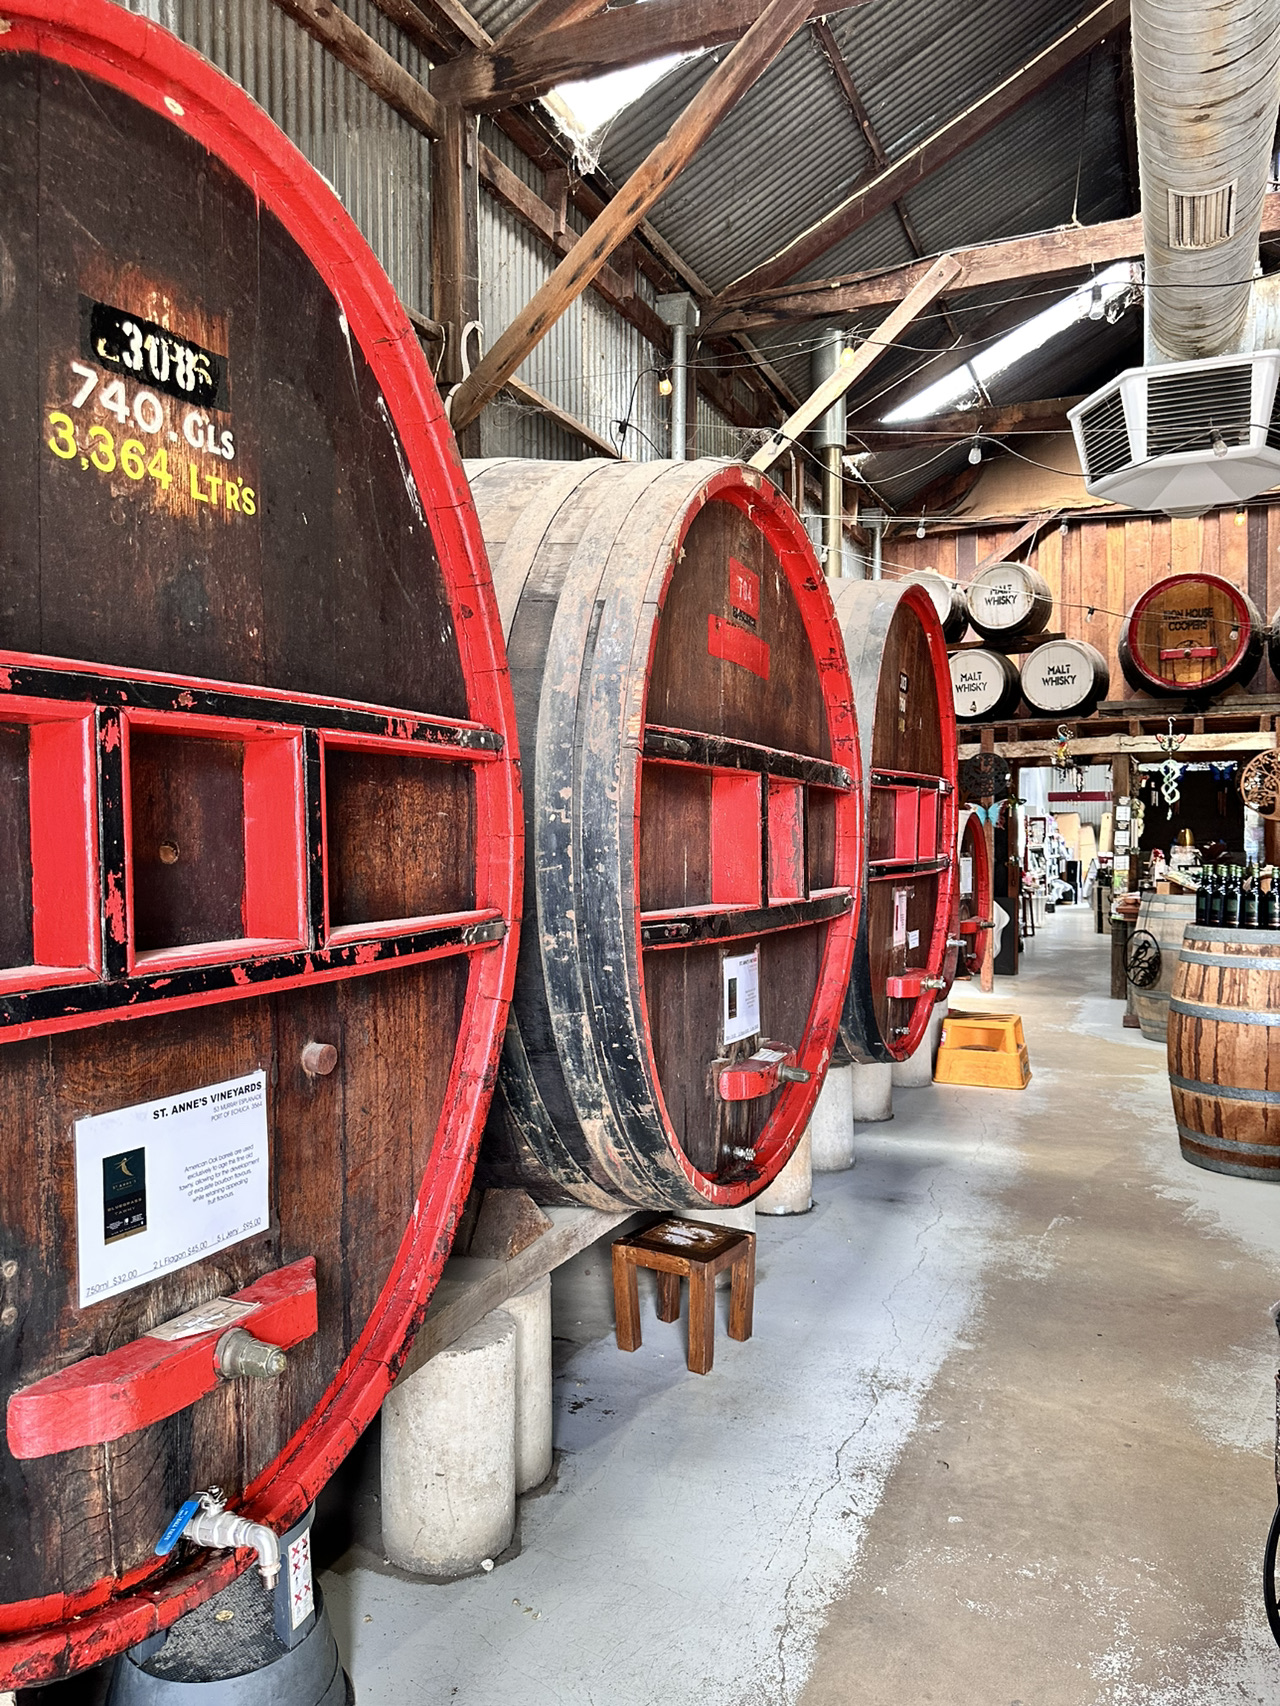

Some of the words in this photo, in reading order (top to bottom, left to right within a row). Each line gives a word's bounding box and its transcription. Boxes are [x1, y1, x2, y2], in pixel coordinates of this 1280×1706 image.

[48, 411, 173, 490] 3,364
[189, 463, 256, 516] LTR'S
[984, 594, 1018, 606] WHISKY
[1185, 607, 1214, 619] HOUSE
[1168, 619, 1208, 632] COOPERS
[1047, 664, 1071, 675] MALT
[960, 671, 982, 682] MALT
[1041, 675, 1077, 686] WHISKY
[955, 682, 988, 693] WHISKY
[153, 1107, 168, 1120] ST.
[171, 1097, 207, 1114] ANNE'S
[210, 1081, 261, 1103] VINEYARDS
[211, 1113, 222, 1121] PORT
[184, 1160, 207, 1172] American
[219, 1151, 233, 1160] barrels
[187, 1167, 211, 1180] exclusively
[195, 1174, 213, 1186] allowing
[230, 1157, 259, 1172] development
[215, 1175, 232, 1186] bourbon
[226, 1177, 248, 1191] appealing
[86, 1280, 108, 1297] 750ml
[112, 1268, 137, 1286] $32.00
[153, 1261, 157, 1269] 2
[164, 1249, 185, 1267] Flagon
[187, 1239, 207, 1256] $45.00
[242, 1216, 261, 1231] $95.00
